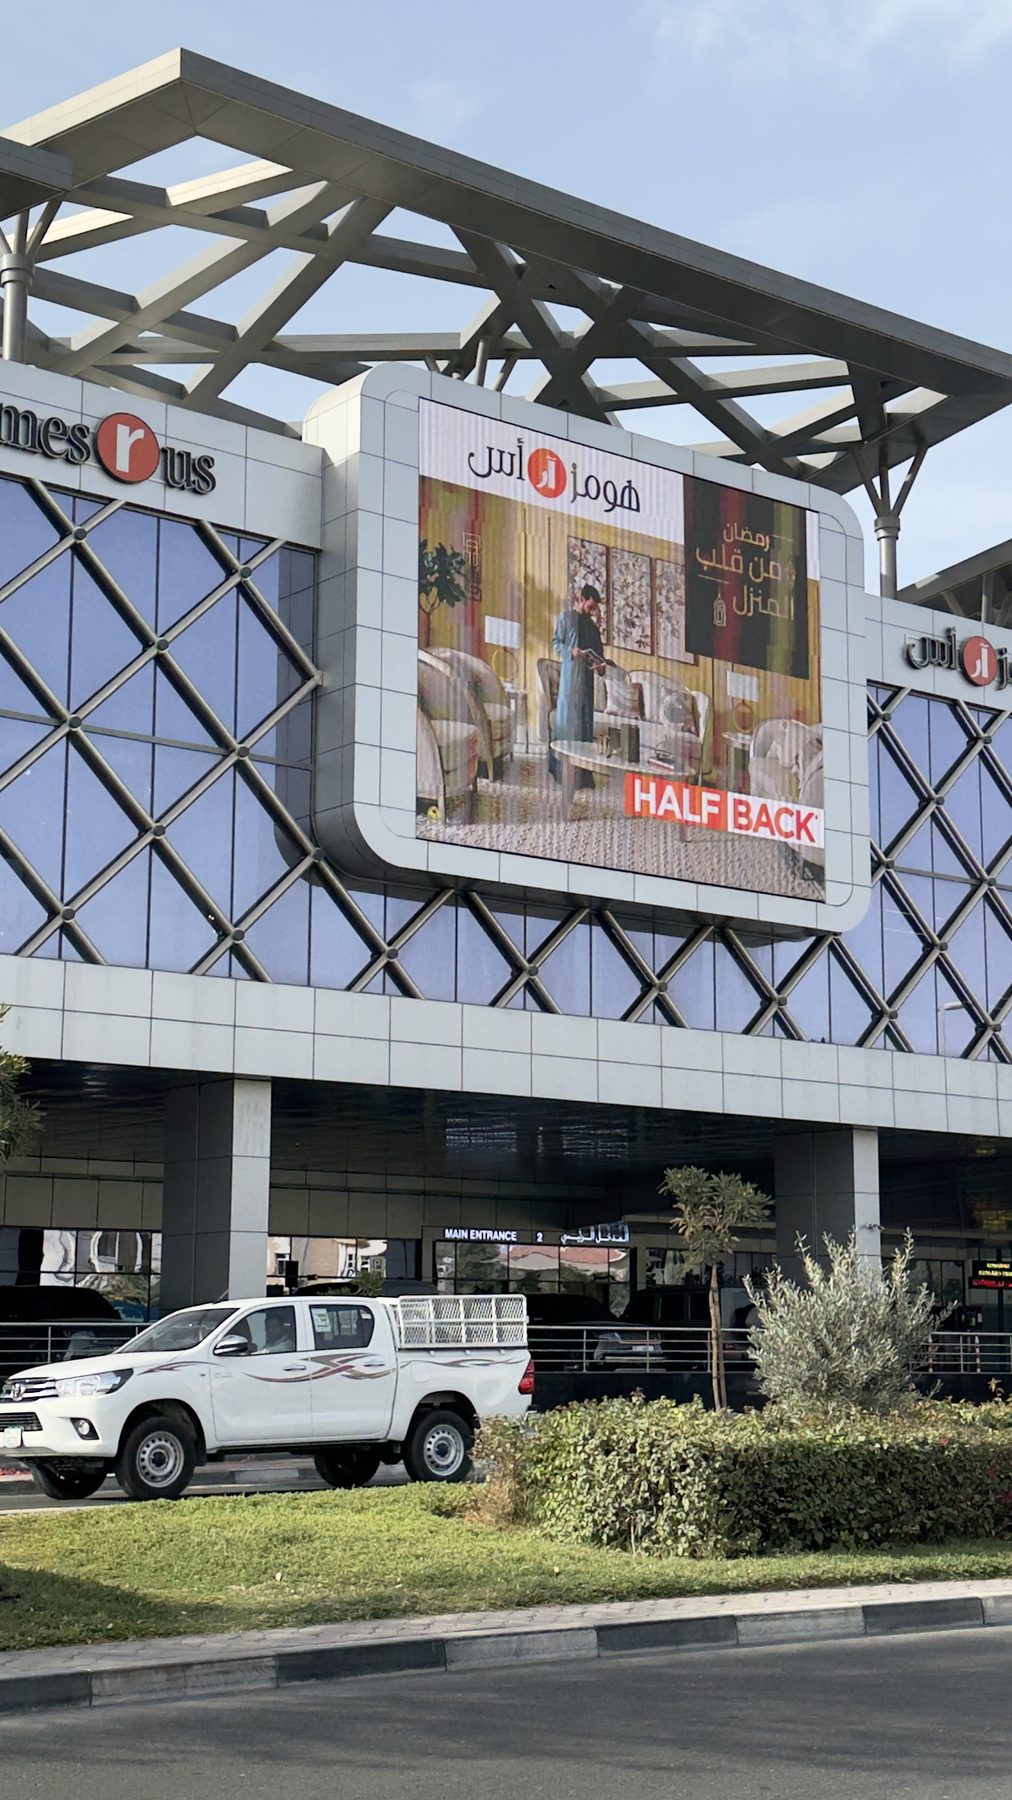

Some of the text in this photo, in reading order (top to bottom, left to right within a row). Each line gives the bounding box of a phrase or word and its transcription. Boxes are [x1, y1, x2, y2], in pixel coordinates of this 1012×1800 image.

[116, 424, 144, 473] r
[160, 446, 216, 495] us
[571, 462, 640, 513] هومز
[723, 522, 770, 552] رمضان
[696, 544, 781, 583] من قلب
[733, 585, 794, 621] المنزل
[633, 778, 720, 825] HALF
[444, 1228, 543, 1242] MAIN ENTRANCE 2
